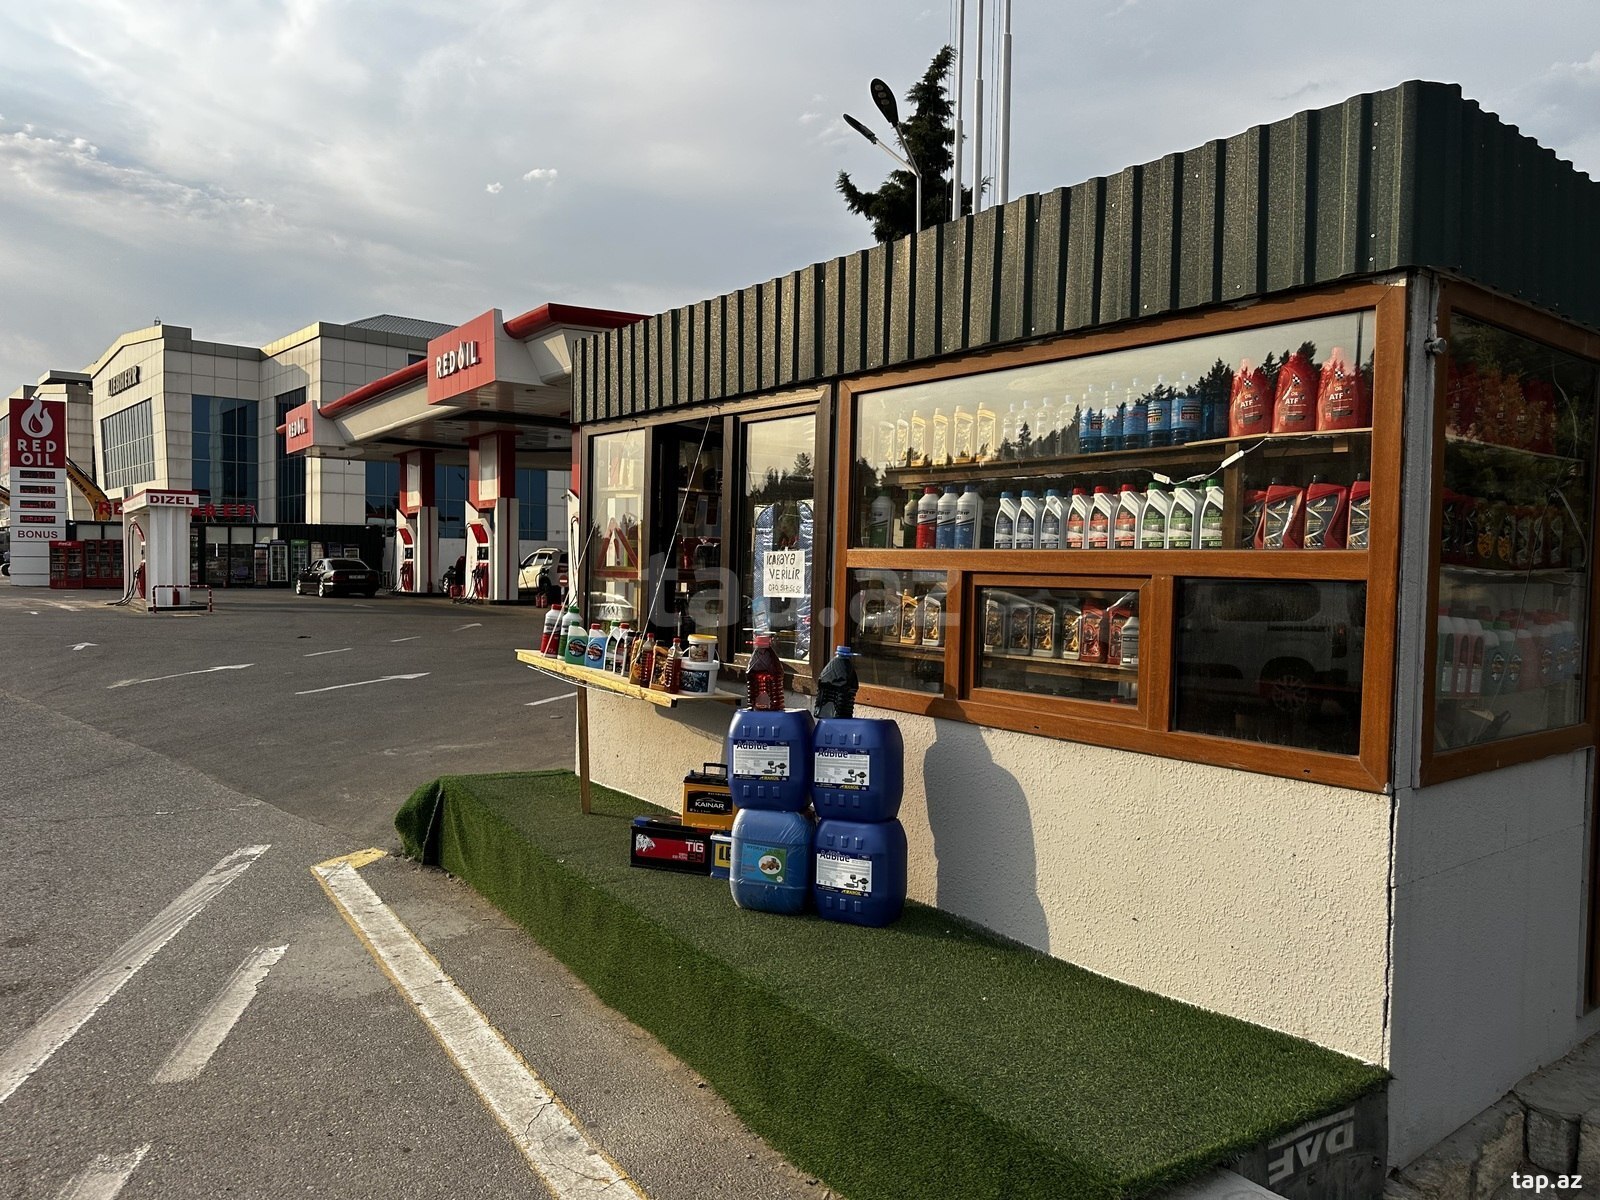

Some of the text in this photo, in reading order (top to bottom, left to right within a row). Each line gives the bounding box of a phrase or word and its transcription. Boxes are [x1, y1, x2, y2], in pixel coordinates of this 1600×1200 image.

[436, 350, 457, 379] RED
[1240, 399, 1253, 408] ATF
[1284, 397, 1299, 405] ATF
[17, 438, 57, 453] RED
[20, 452, 54, 466] OIL
[150, 495, 195, 506] DIZEL
[17, 530, 59, 539] BONUS
[769, 566, 801, 580] VERİLİR
[736, 740, 768, 751] AdBlue
[818, 748, 849, 759] AdBlue
[694, 801, 725, 810] KAINAR
[685, 841, 704, 853] TIG
[820, 850, 850, 863] AdBlue
[1268, 1120, 1354, 1186] DAF
